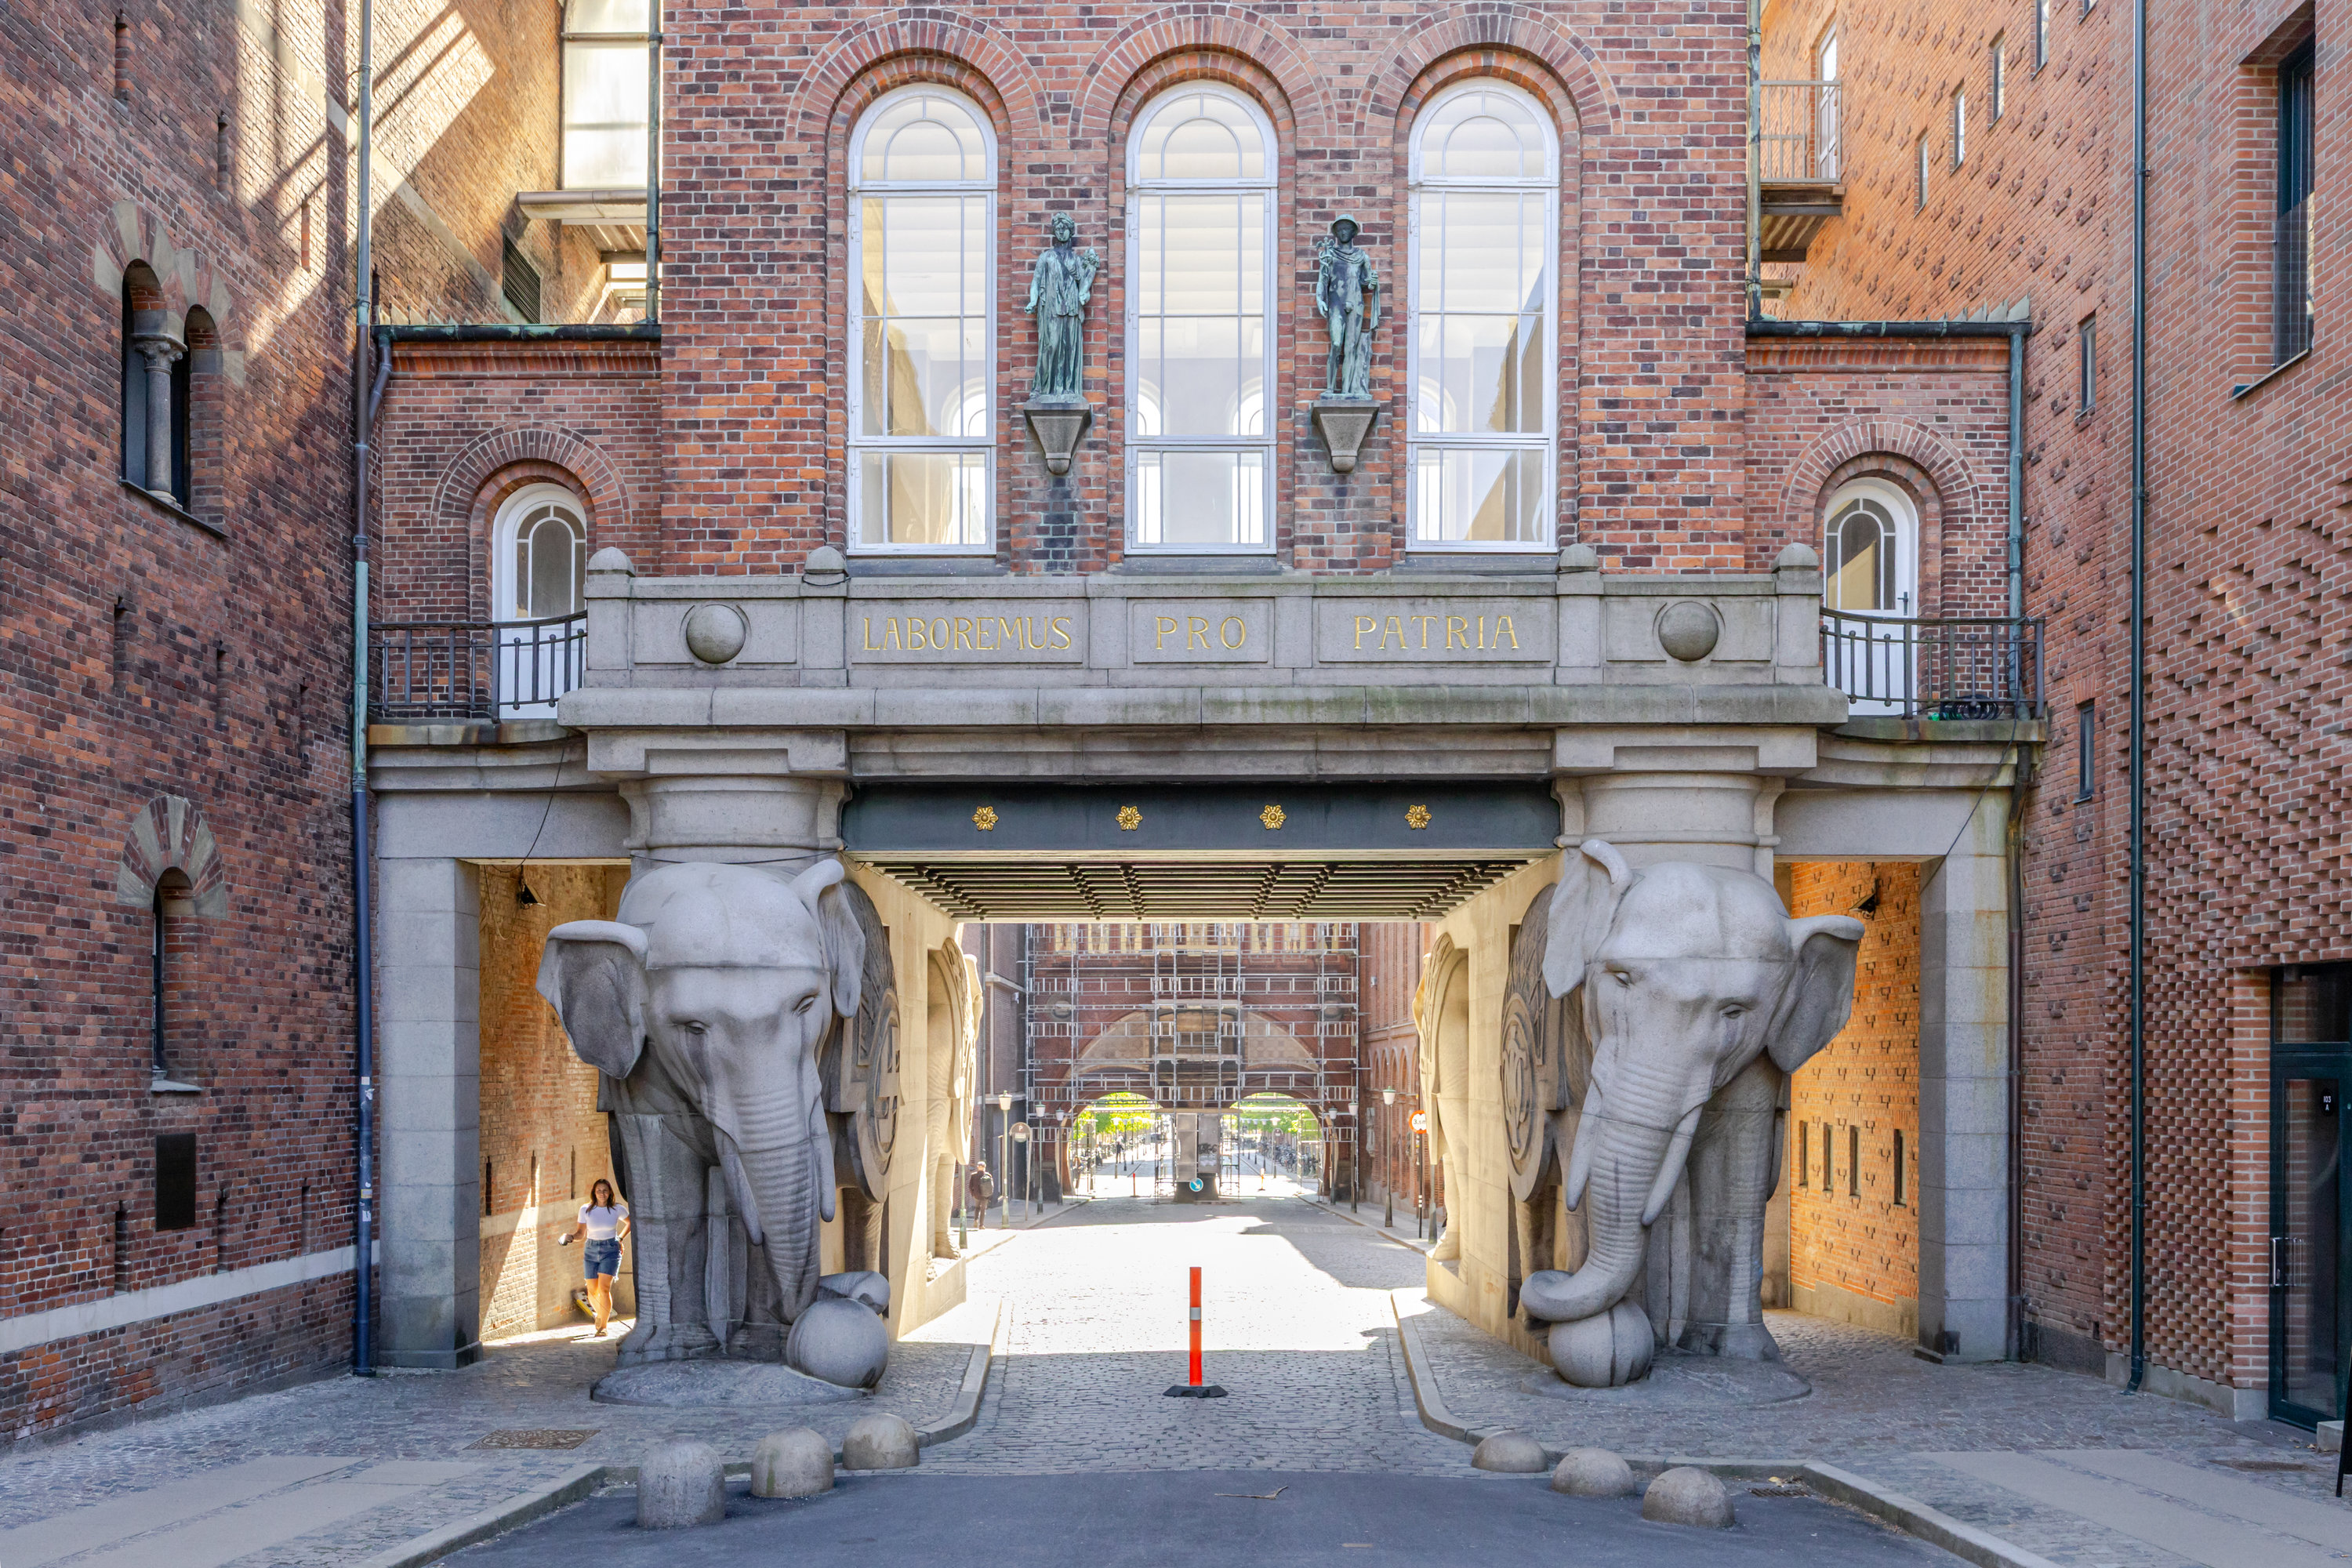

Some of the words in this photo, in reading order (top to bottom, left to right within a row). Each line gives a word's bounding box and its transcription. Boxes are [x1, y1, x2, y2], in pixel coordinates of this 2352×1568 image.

[864, 616, 1072, 650] LABOREMUS
[1156, 616, 1247, 649] PRO
[1355, 615, 1519, 649] PATRIA
